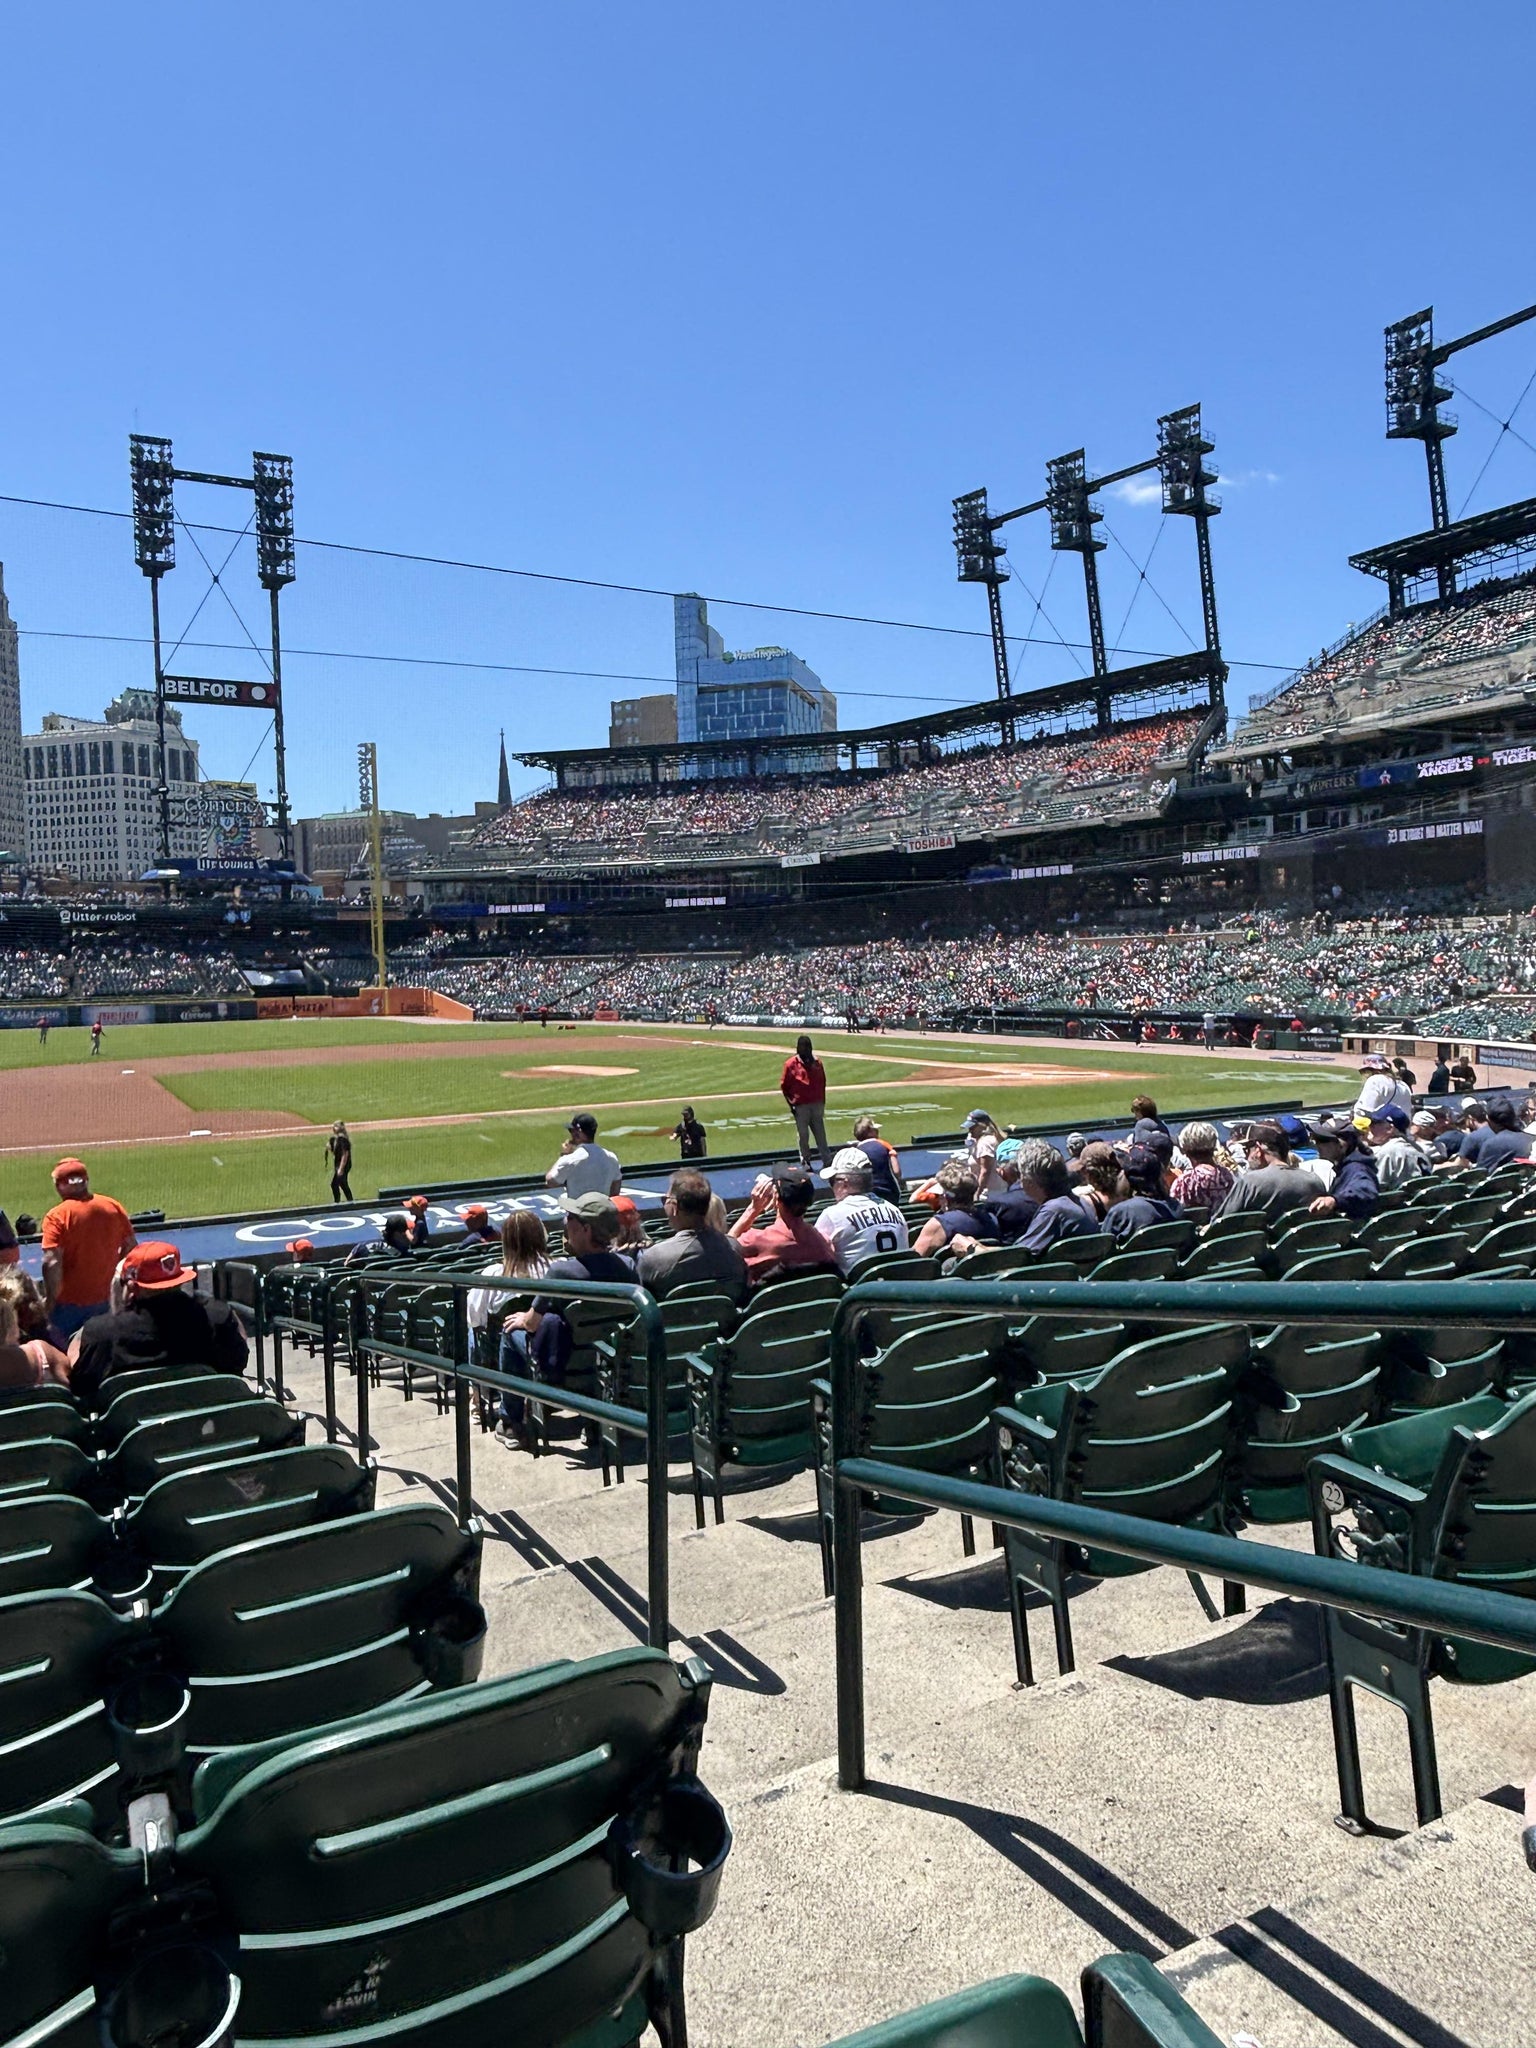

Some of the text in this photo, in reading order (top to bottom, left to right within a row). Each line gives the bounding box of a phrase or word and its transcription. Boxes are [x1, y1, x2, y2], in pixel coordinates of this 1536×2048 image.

[164, 679, 238, 699] BELFOR
[1418, 761, 1474, 779] ANGELS
[908, 836, 954, 851] TOSHIBA
[1325, 1485, 1342, 1506] 22
